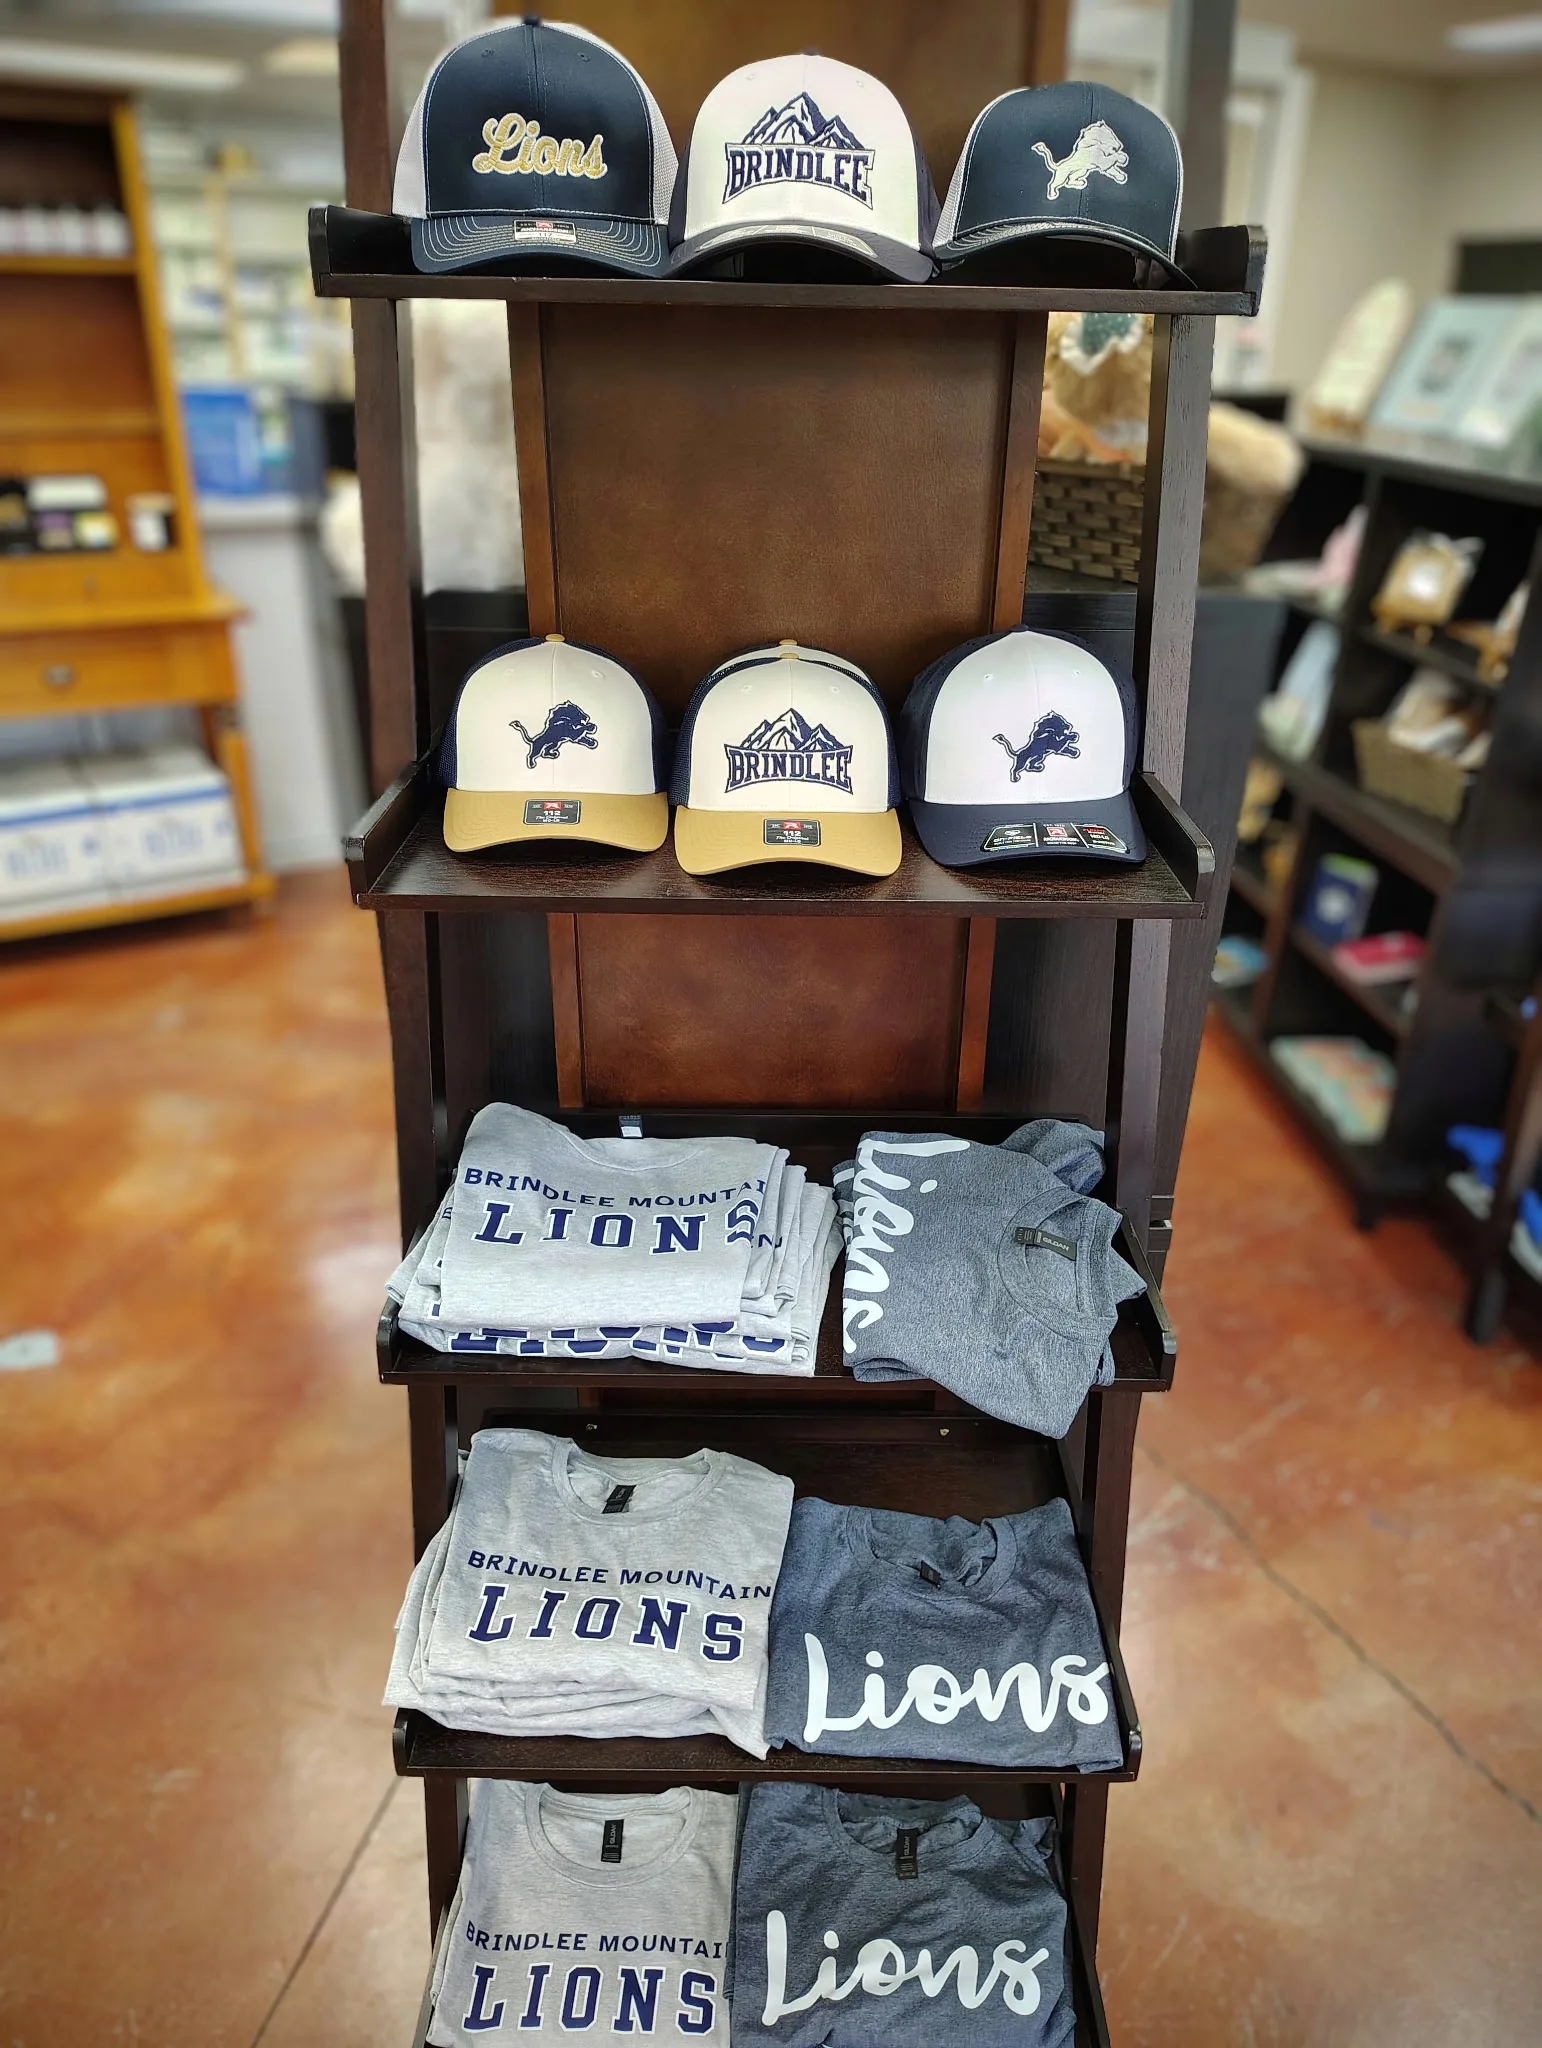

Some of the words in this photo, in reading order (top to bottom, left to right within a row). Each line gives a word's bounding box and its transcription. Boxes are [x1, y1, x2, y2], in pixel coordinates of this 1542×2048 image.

[472, 112, 608, 179] Lions
[727, 147, 870, 202] BRINDLEE
[728, 749, 850, 790] BRINDLEE
[464, 1167, 615, 1208] BRINDLEE
[628, 1179, 766, 1209] MOUNTAI
[471, 1198, 760, 1256] LIONS
[1042, 1237, 1070, 1252] GILDAN
[467, 1550, 609, 1584] BRINDLEE
[619, 1568, 771, 1600] MOUNTAIN
[466, 1583, 745, 1662] LIONS
[803, 1632, 1111, 1743] Lions
[466, 1920, 588, 1951] BRINDLEE
[598, 1934, 729, 1959] MOUNTAI
[761, 1910, 1050, 2026] Lions
[462, 1961, 717, 2037] LIONS
